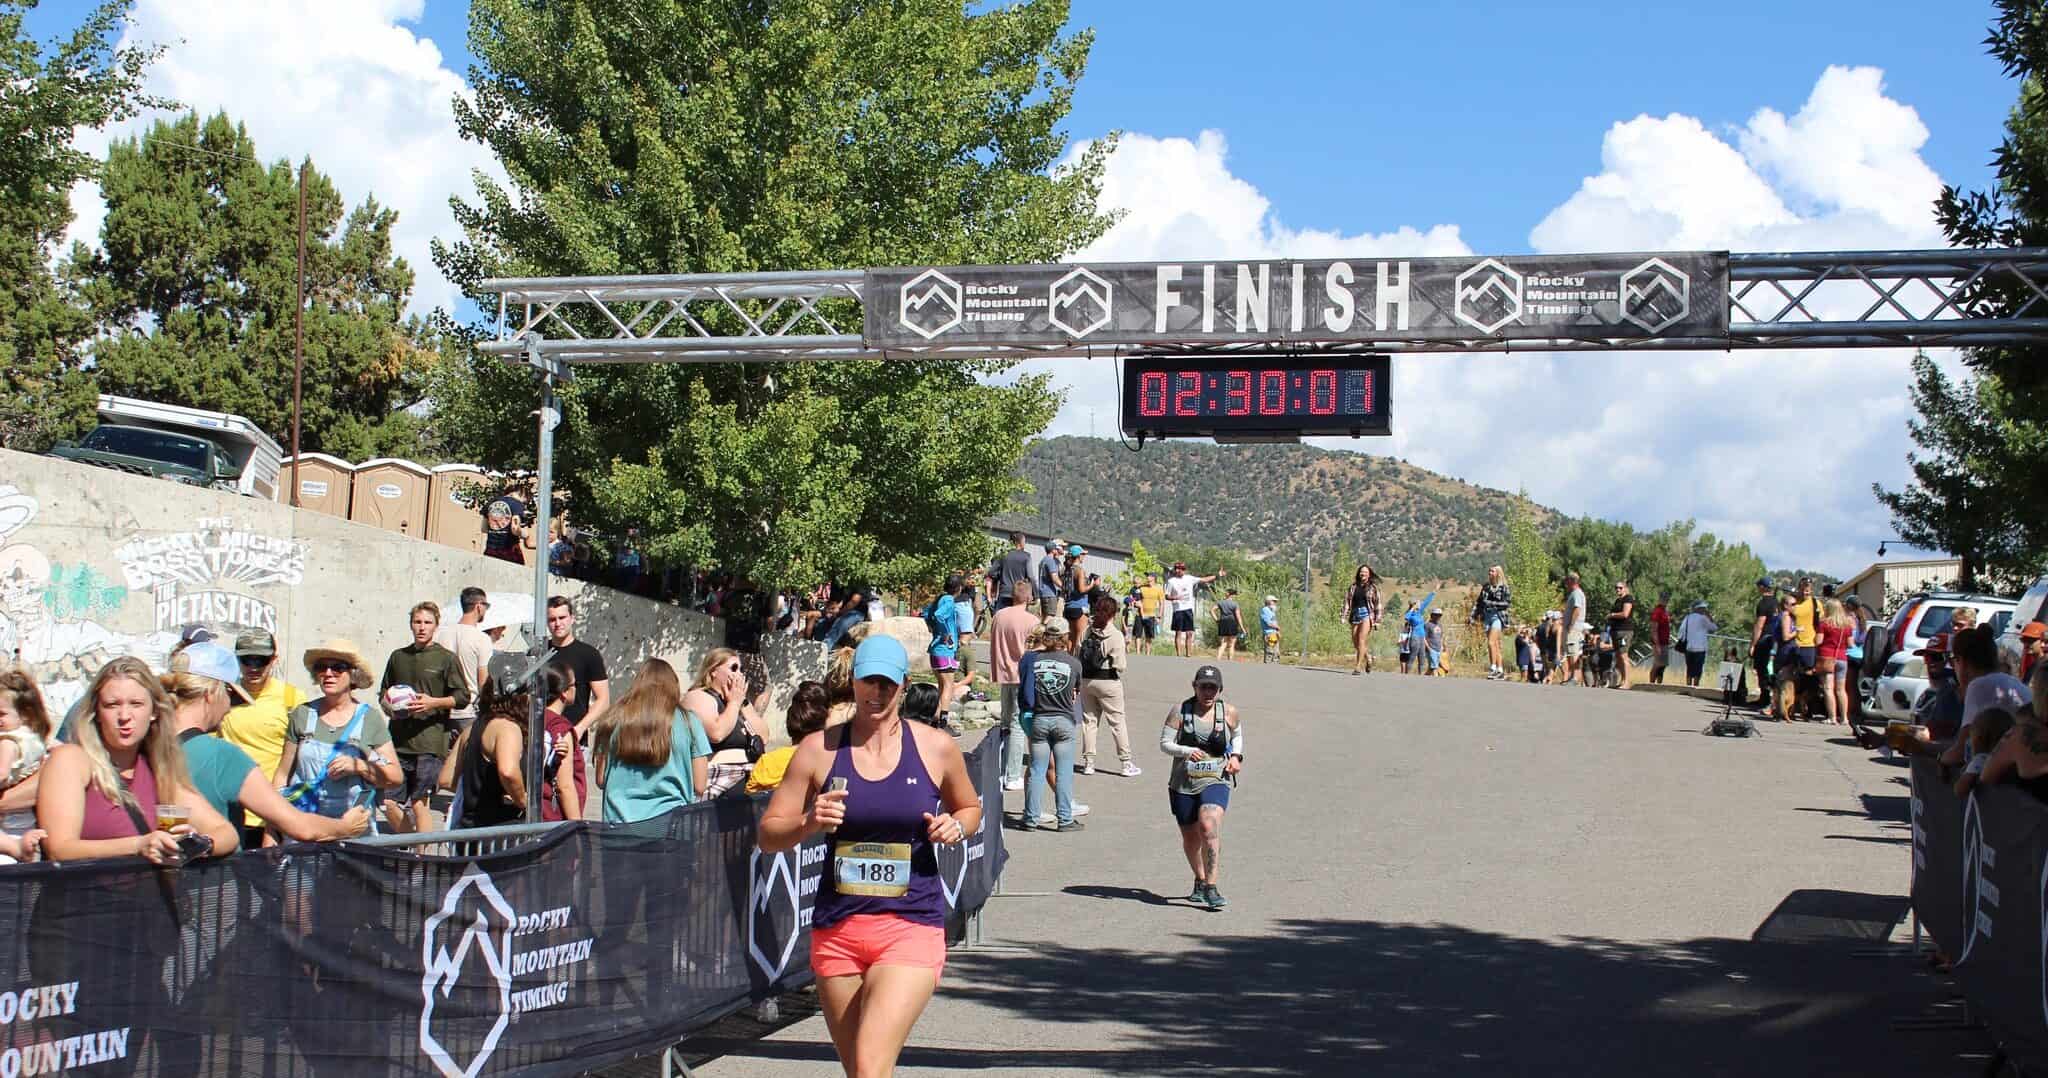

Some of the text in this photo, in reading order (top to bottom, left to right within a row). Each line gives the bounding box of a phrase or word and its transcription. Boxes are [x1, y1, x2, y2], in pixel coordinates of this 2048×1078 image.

[965, 284, 1018, 296] Rocky
[1526, 275, 1585, 287] Rocky
[965, 297, 1048, 309] Mountain
[1154, 261, 1411, 334] FINISH
[1526, 289, 1618, 301] Mountain
[964, 311, 1026, 322] Timing
[1526, 304, 1593, 315] Timing
[1139, 370, 1372, 416] 02:30:01
[197, 516, 233, 529] THE
[155, 581, 177, 600] THE
[156, 590, 276, 633] PIETASTERS
[1195, 762, 1211, 771] 474
[857, 862, 896, 883] 188
[514, 906, 571, 936] ROCKY
[512, 938, 593, 976] MOUNTAIN
[0, 981, 80, 1024] OCKY
[511, 981, 569, 1013] TIMING
[0, 1027, 130, 1078] OUNTAIN
